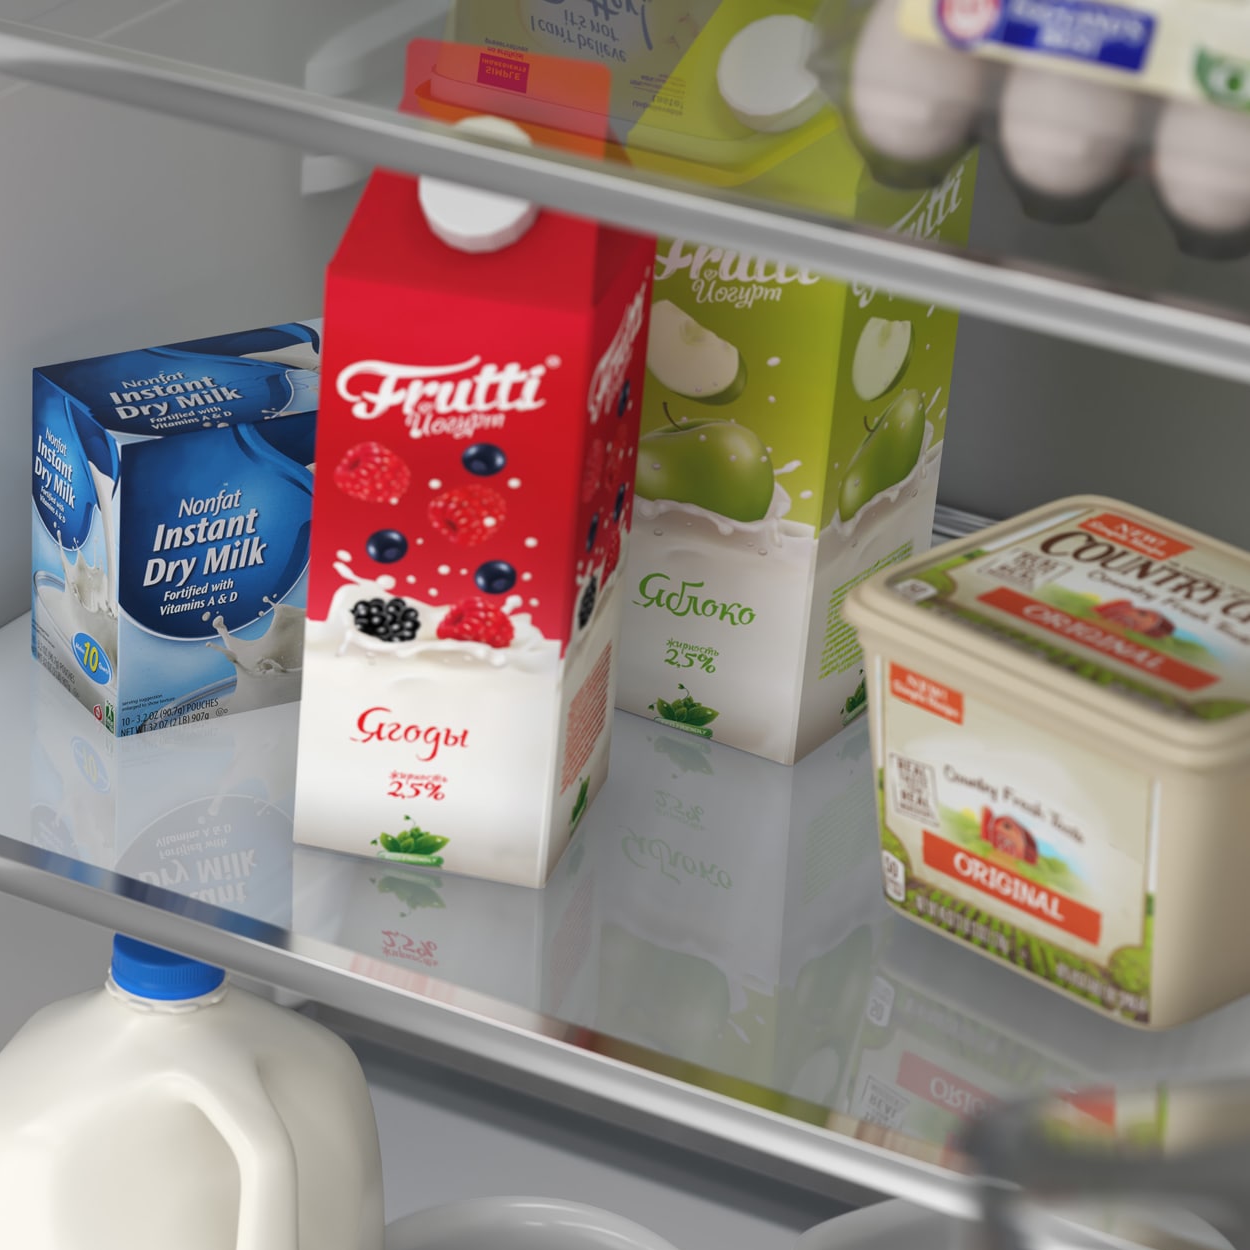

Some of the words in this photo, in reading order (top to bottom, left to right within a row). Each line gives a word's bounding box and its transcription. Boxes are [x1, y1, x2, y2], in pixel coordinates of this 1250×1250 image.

[109, 376, 217, 405] Instant
[122, 371, 185, 389] Nonfat
[336, 354, 547, 420] Frutti
[115, 402, 170, 420] Dry
[175, 388, 243, 410] Milk
[150, 410, 196, 424] Fortified
[198, 406, 222, 416] with
[151, 416, 200, 430] Vitamins
[202, 414, 209, 422] A
[224, 410, 232, 418] D
[46, 426, 67, 456] Nonfat
[37, 435, 72, 482] Instant
[34, 456, 52, 488] Dry
[53, 474, 76, 509] Milk
[178, 489, 242, 518] Nonfat
[153, 508, 259, 552] Instant
[143, 556, 197, 587] Dry
[202, 536, 268, 575] Milk
[1040, 531, 1225, 604] COUNTRY
[160, 599, 205, 616] Vitamins
[208, 596, 215, 606] A
[217, 594, 227, 604] &
[230, 592, 238, 602] D
[164, 582, 208, 601] Fortified
[211, 578, 234, 592] with
[631, 572, 756, 625] Яблоко
[1022, 604, 1166, 670] ORIGINAL
[84, 641, 99, 673] 10
[122, 717, 130, 726] 10
[150, 711, 159, 720] OZ
[186, 698, 219, 712] POUCHES
[120, 726, 134, 736] NET
[350, 707, 469, 762] Ягоды
[943, 763, 1000, 800] Country
[1002, 785, 1042, 817] Fresh
[952, 852, 1066, 922] ORIGINAL
